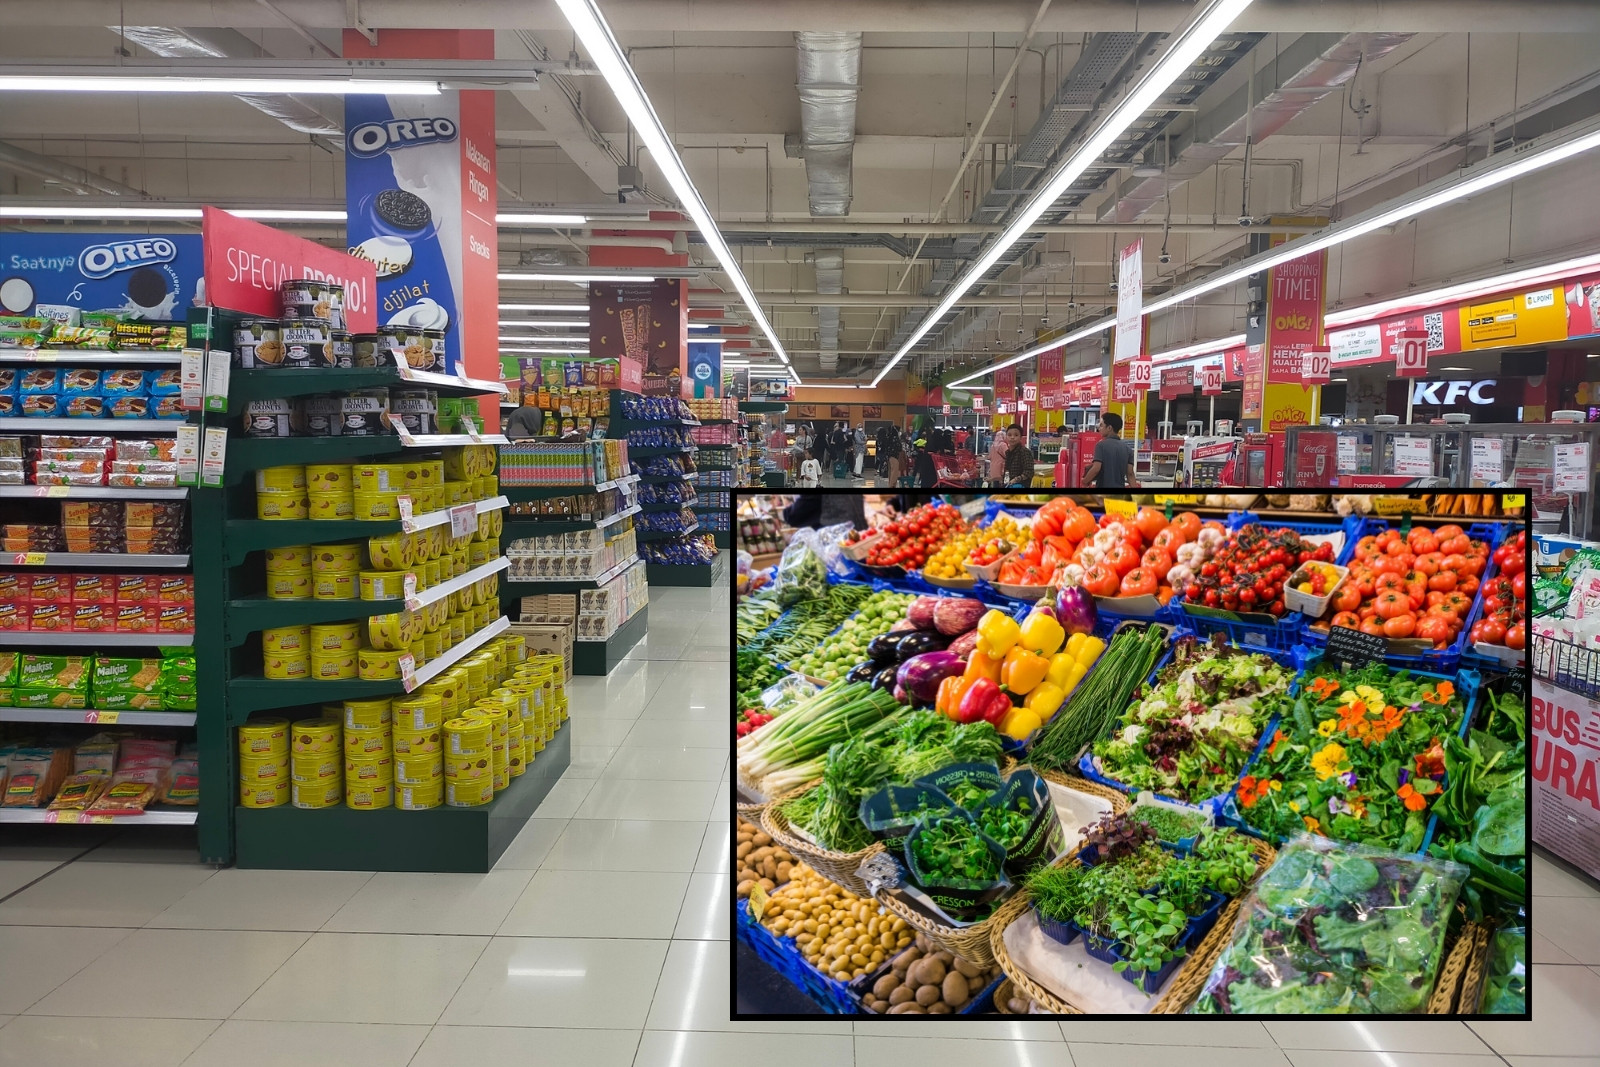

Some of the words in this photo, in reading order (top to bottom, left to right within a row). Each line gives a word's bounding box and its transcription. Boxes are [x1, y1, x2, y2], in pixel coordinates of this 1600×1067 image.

[352, 118, 456, 154] OREO
[465, 138, 491, 174] Makanan
[469, 171, 489, 202] Ringan
[469, 235, 490, 260] Snacks
[11, 255, 75, 272] Saatnya
[84, 241, 172, 272] OREO
[1278, 263, 1318, 277] SHOPPING
[1275, 277, 1317, 301] TIME!
[383, 280, 429, 312] dijilat
[38, 309, 70, 320] Saltines
[1275, 312, 1313, 331] OMG!
[117, 325, 152, 335] biscuit
[1272, 349, 1304, 359] HEMA
[1404, 340, 1427, 367] 01
[1041, 359, 1062, 371] TIME!
[1312, 357, 1329, 375] 02
[1136, 364, 1152, 381] 03
[1207, 373, 1221, 388] 04
[1026, 388, 1036, 399] 07
[1121, 383, 1132, 397] 06
[1412, 379, 1497, 405] KFC
[1045, 398, 1054, 407] 10
[1081, 392, 1091, 402] 08
[976, 400, 983, 408] 11
[1273, 406, 1306, 424] OMG!
[33, 577, 57, 587] Magic
[76, 578, 99, 588] Magic
[120, 579, 143, 590] Magic
[161, 580, 185, 591] Magic
[33, 605, 57, 616] Magic
[76, 606, 99, 617] Magic
[119, 608, 142, 619] Magic
[161, 609, 185, 619] Magic
[24, 661, 54, 675] Malkist
[97, 664, 129, 677] Malkist
[29, 693, 49, 702] Malkist
[106, 695, 126, 704] Malkist
[1532, 695, 1581, 746] BUS
[1006, 823, 1043, 860] WATERKERS
[929, 895, 975, 908] CRESSON
